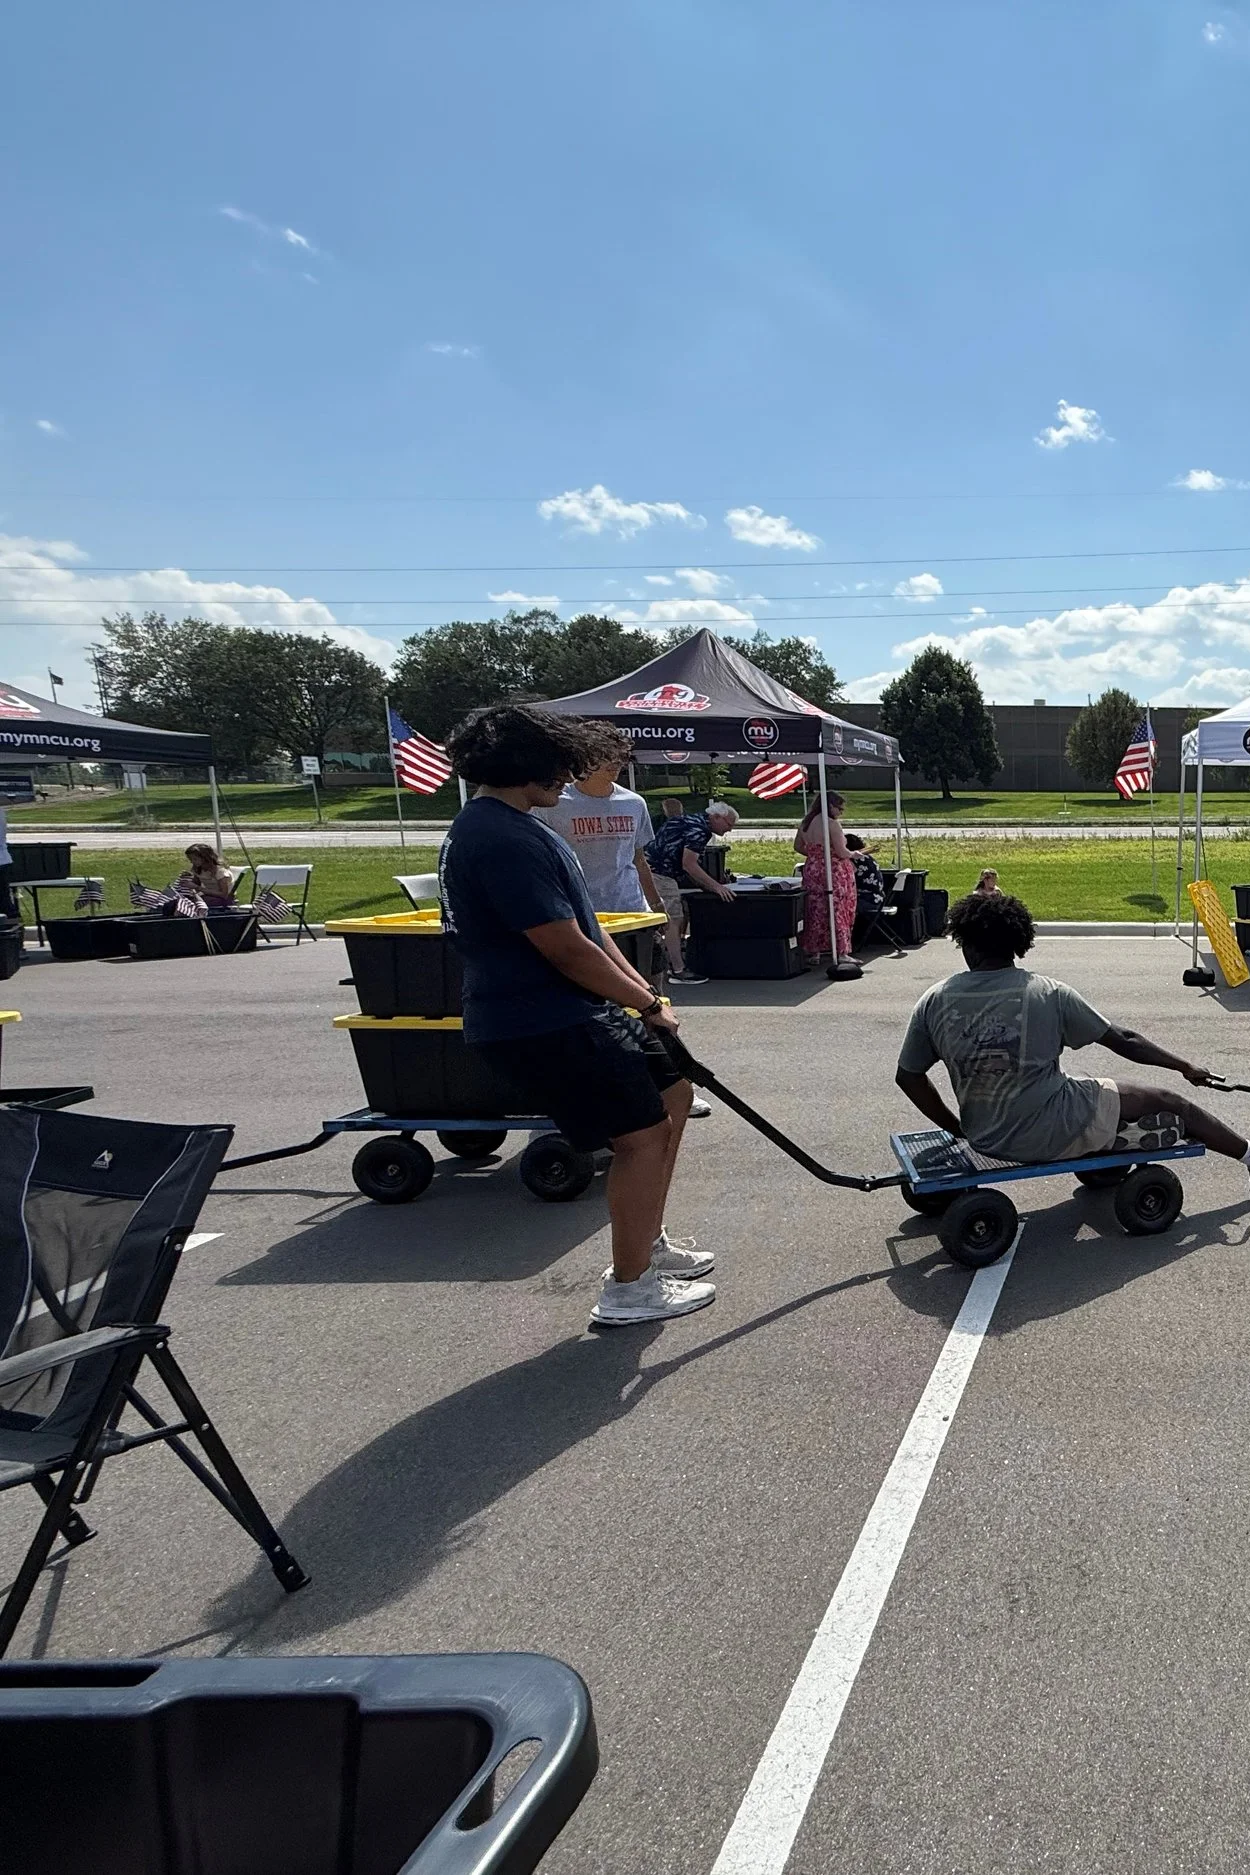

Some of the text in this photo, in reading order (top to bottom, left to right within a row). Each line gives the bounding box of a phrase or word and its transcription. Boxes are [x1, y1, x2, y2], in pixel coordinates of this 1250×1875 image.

[616, 727, 695, 742] mncu.org
[748, 726, 774, 739] my
[0, 732, 101, 752] mymncu.org
[571, 815, 635, 835] IOWA STATE
